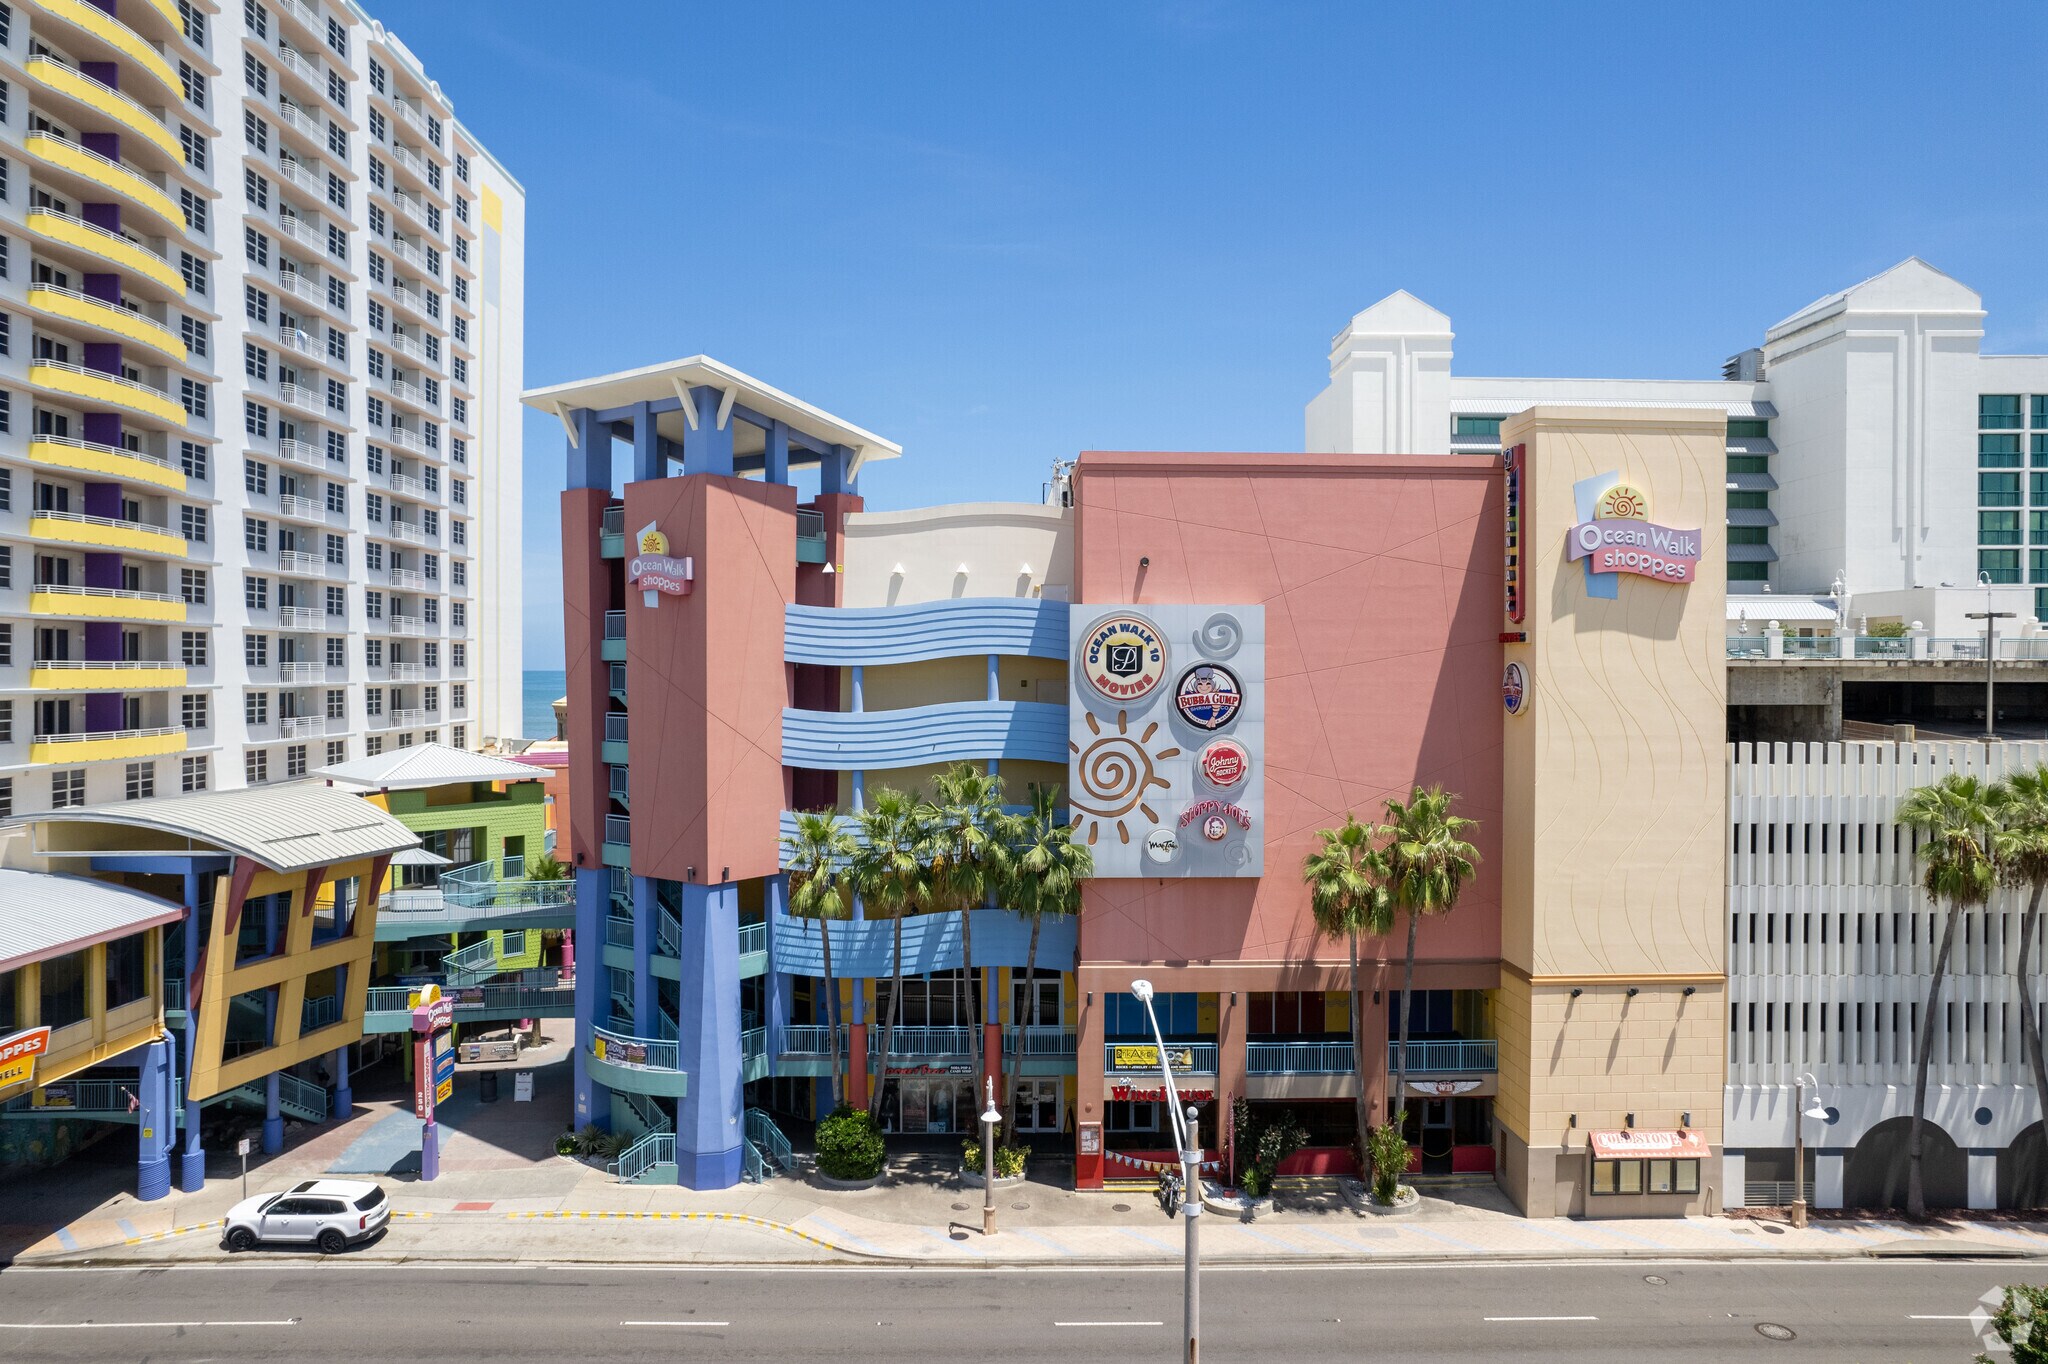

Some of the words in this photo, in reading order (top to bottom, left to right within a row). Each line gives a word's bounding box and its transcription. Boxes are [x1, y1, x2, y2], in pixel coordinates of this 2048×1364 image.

[1580, 525, 1647, 551] Ocean
[1650, 527, 1696, 556] Walk
[632, 559, 662, 576] Ocean
[663, 559, 684, 576] Walk
[1604, 549, 1686, 578] shoppes
[643, 575, 680, 591] shoppes
[1089, 625, 1118, 664] OCEAN
[1119, 623, 1154, 646] WALK
[1150, 648, 1160, 662] 10
[1096, 673, 1154, 695] MOVIES
[1180, 694, 1211, 708] BUBBA
[1212, 693, 1239, 705] GUMP
[1210, 755, 1239, 773] Johnny
[1215, 767, 1238, 776] ROCKETS
